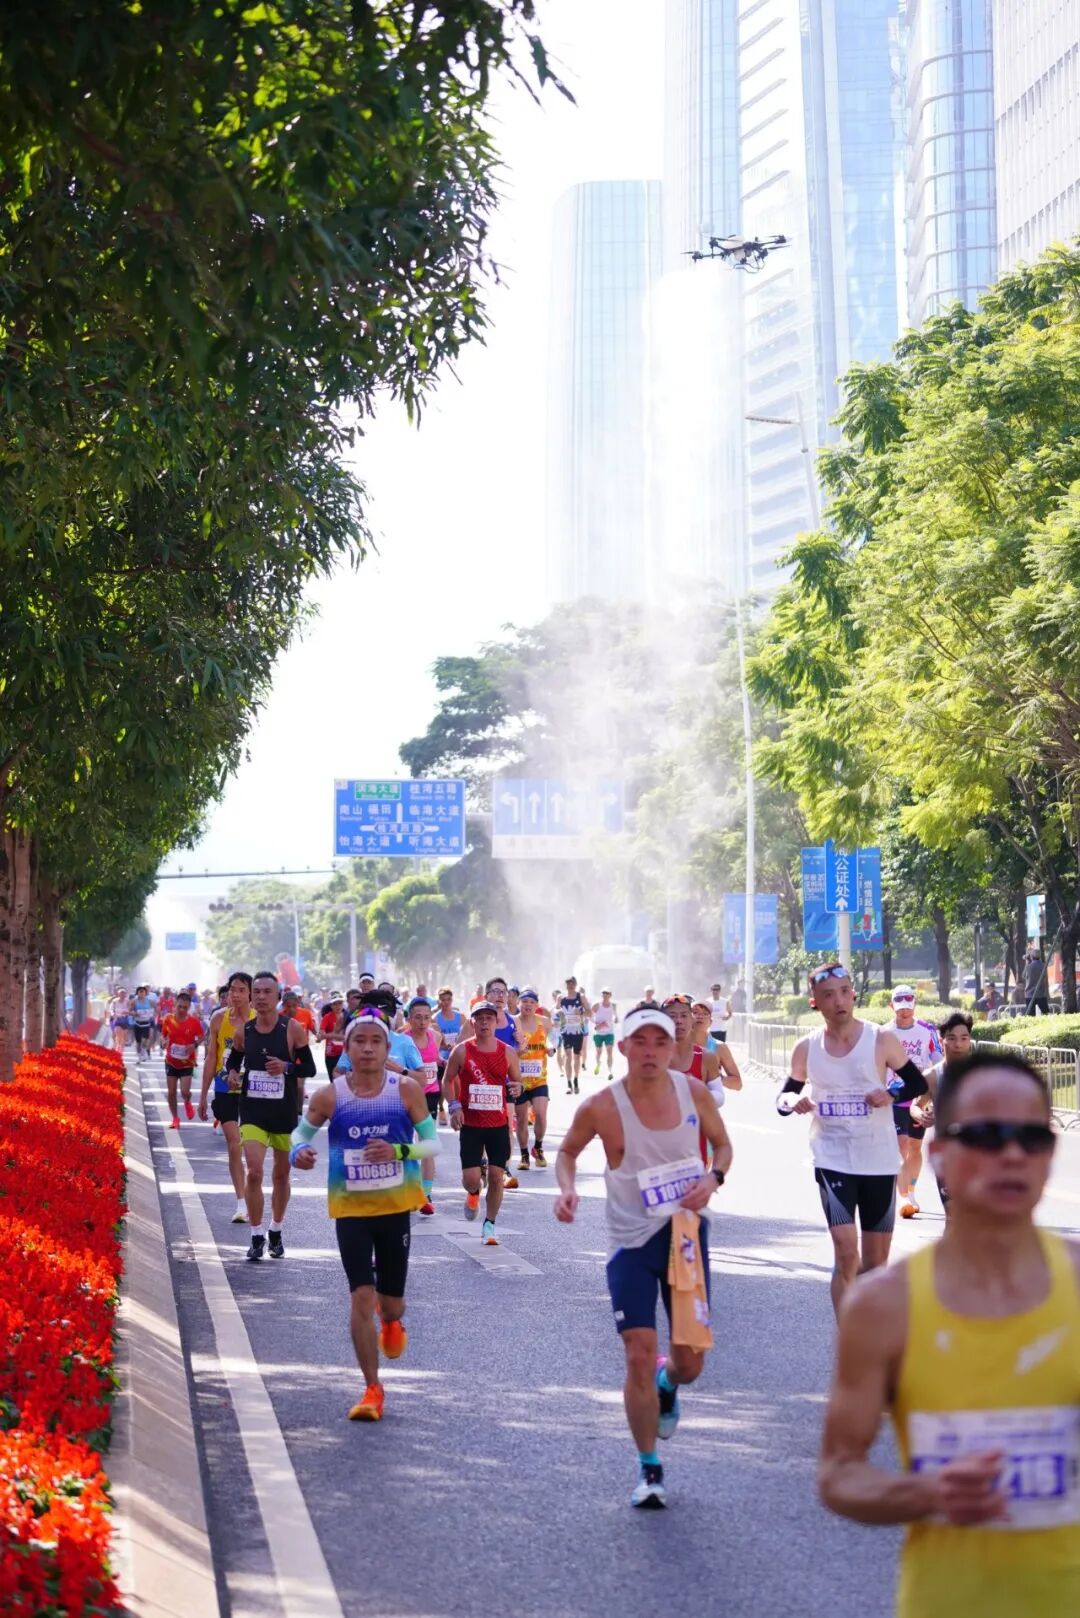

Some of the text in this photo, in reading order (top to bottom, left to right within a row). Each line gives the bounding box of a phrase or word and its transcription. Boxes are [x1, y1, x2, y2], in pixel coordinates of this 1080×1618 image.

[822, 1102, 865, 1116] B 10983
[347, 1162, 395, 1180] B 10688
[646, 1188, 660, 1206] B
